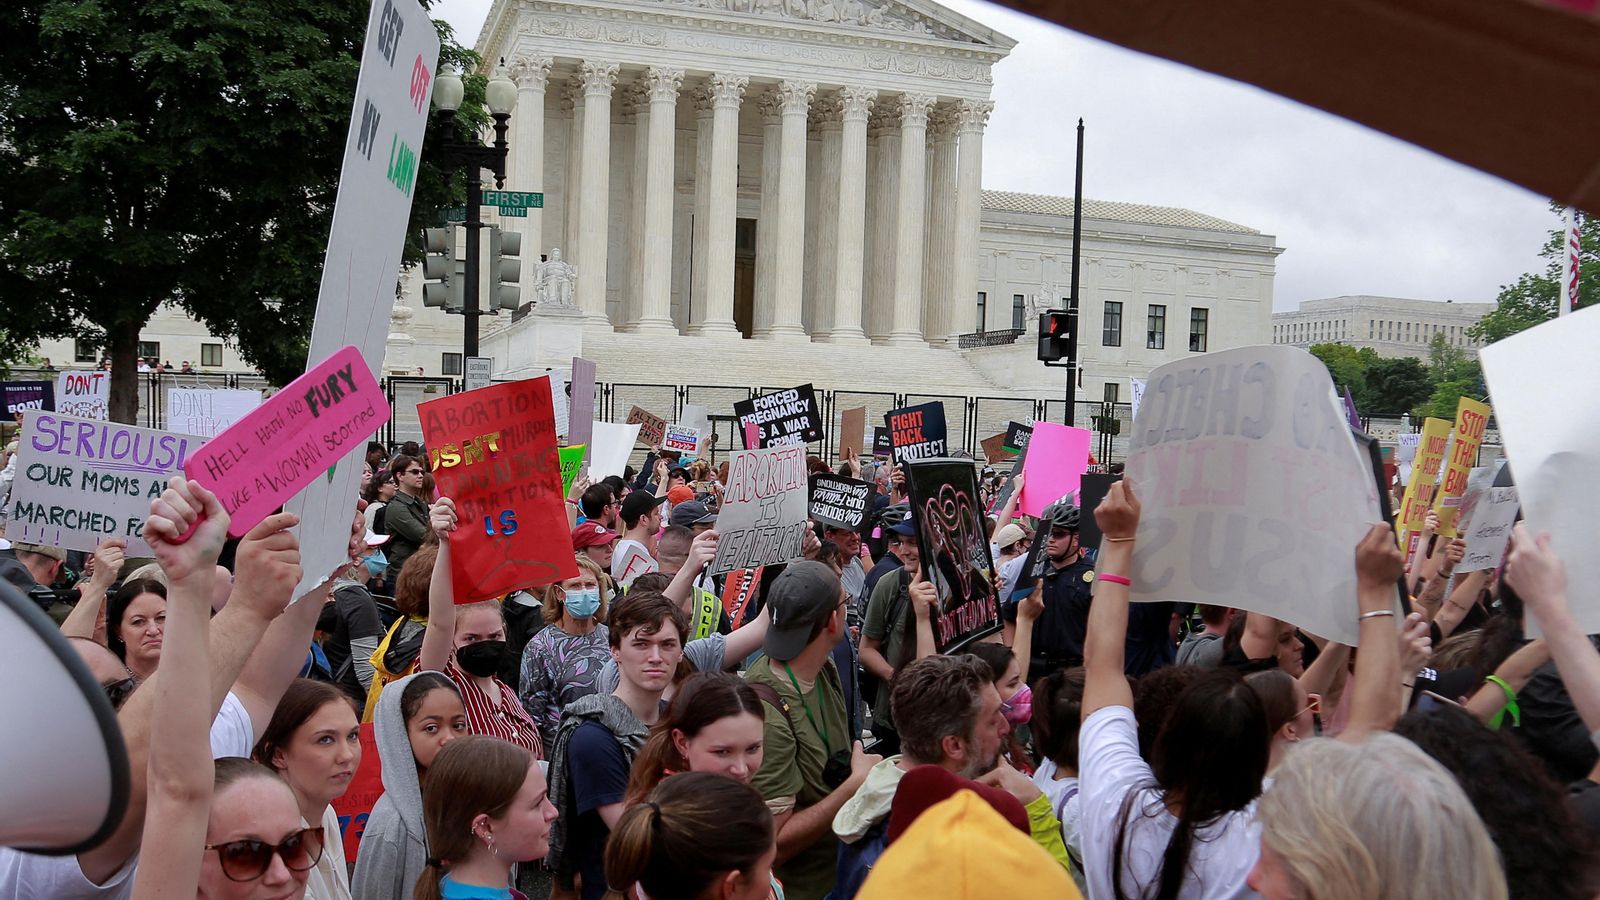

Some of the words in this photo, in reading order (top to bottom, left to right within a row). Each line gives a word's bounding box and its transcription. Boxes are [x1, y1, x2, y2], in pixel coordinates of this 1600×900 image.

[377, 0, 404, 68] GET
[410, 53, 431, 114] OFF
[676, 34, 721, 50] EQUAL
[722, 39, 777, 56] JUSTICE
[782, 45, 826, 61] UNDER
[830, 51, 856, 64] LAW
[357, 98, 381, 161] MY
[386, 132, 417, 198] LAWN
[486, 192, 530, 207] FIRST
[500, 207, 527, 217] UNIT
[65, 374, 105, 396] DON'T
[752, 388, 800, 412] FORCED
[203, 442, 250, 481] HELL
[286, 398, 304, 420] NO
[303, 362, 358, 419] FURY
[426, 389, 548, 443] ABORTION
[633, 410, 664, 430] ALITO
[740, 398, 810, 429] PREGNANCY
[890, 410, 923, 431] FIGHT
[638, 428, 661, 444] GHTS
[758, 426, 767, 440] S
[771, 423, 780, 437] A
[783, 415, 811, 434] WAR
[892, 427, 927, 447] BACK.
[31, 415, 206, 471] SERIOUSL
[766, 431, 803, 450] CRIME
[894, 439, 944, 462] PROTECT
[1452, 438, 1475, 469] THE
[26, 462, 73, 487] OUR
[81, 470, 140, 497] MOMS
[221, 488, 252, 517] LIKE
[255, 478, 267, 495] A
[263, 435, 324, 494] WOMAN
[816, 478, 853, 493] ABORTIONS
[754, 491, 787, 529] IS
[812, 489, 848, 506] Futures
[845, 495, 866, 510] OUR
[14, 500, 117, 534] MARCHED
[483, 508, 519, 537] IS
[811, 502, 846, 522] BODIES
[705, 519, 808, 577] HEALTHCAR
[735, 572, 744, 592] THE
[701, 596, 712, 636] POLI
